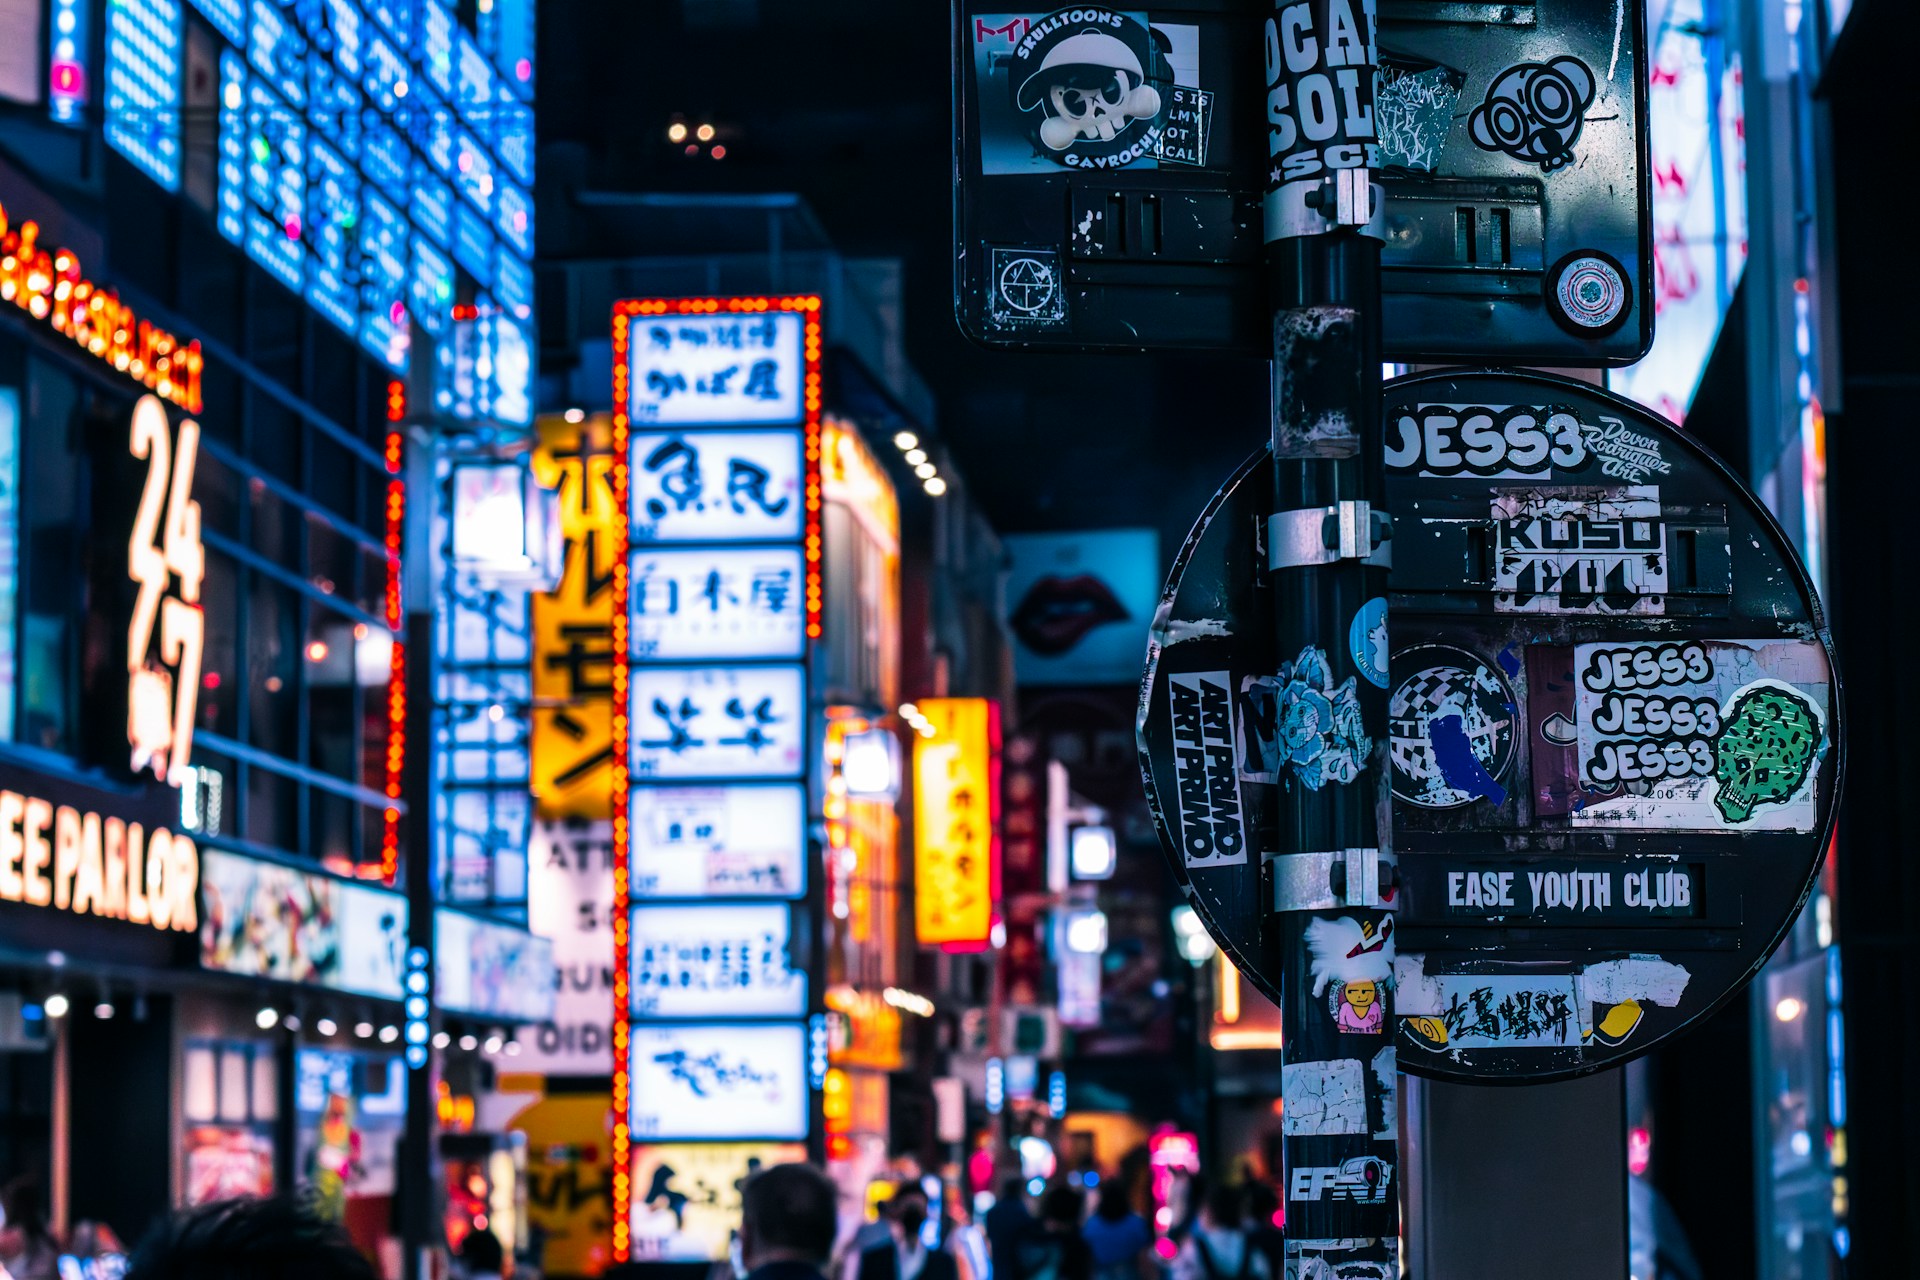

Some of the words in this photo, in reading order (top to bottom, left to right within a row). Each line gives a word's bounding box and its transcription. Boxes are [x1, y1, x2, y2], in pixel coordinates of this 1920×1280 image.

[1017, 9, 1123, 60] SKULLTOONS
[1267, 69, 1378, 157] SOL
[1064, 125, 1161, 169] GAVROCHE
[1385, 413, 1587, 468] JESS3
[1586, 646, 1709, 691] JESS3
[1171, 681, 1204, 748] ART
[1199, 678, 1232, 745] ART
[1597, 697, 1720, 737] JESS3
[1591, 740, 1715, 782] JESS3
[1177, 747, 1214, 859] PRIMO
[1205, 747, 1243, 856] PRIMO
[54, 804, 199, 933] PARLOR
[1448, 872, 1515, 910] EASE
[1527, 867, 1612, 913] YOUTH
[1623, 867, 1692, 913] CLUB
